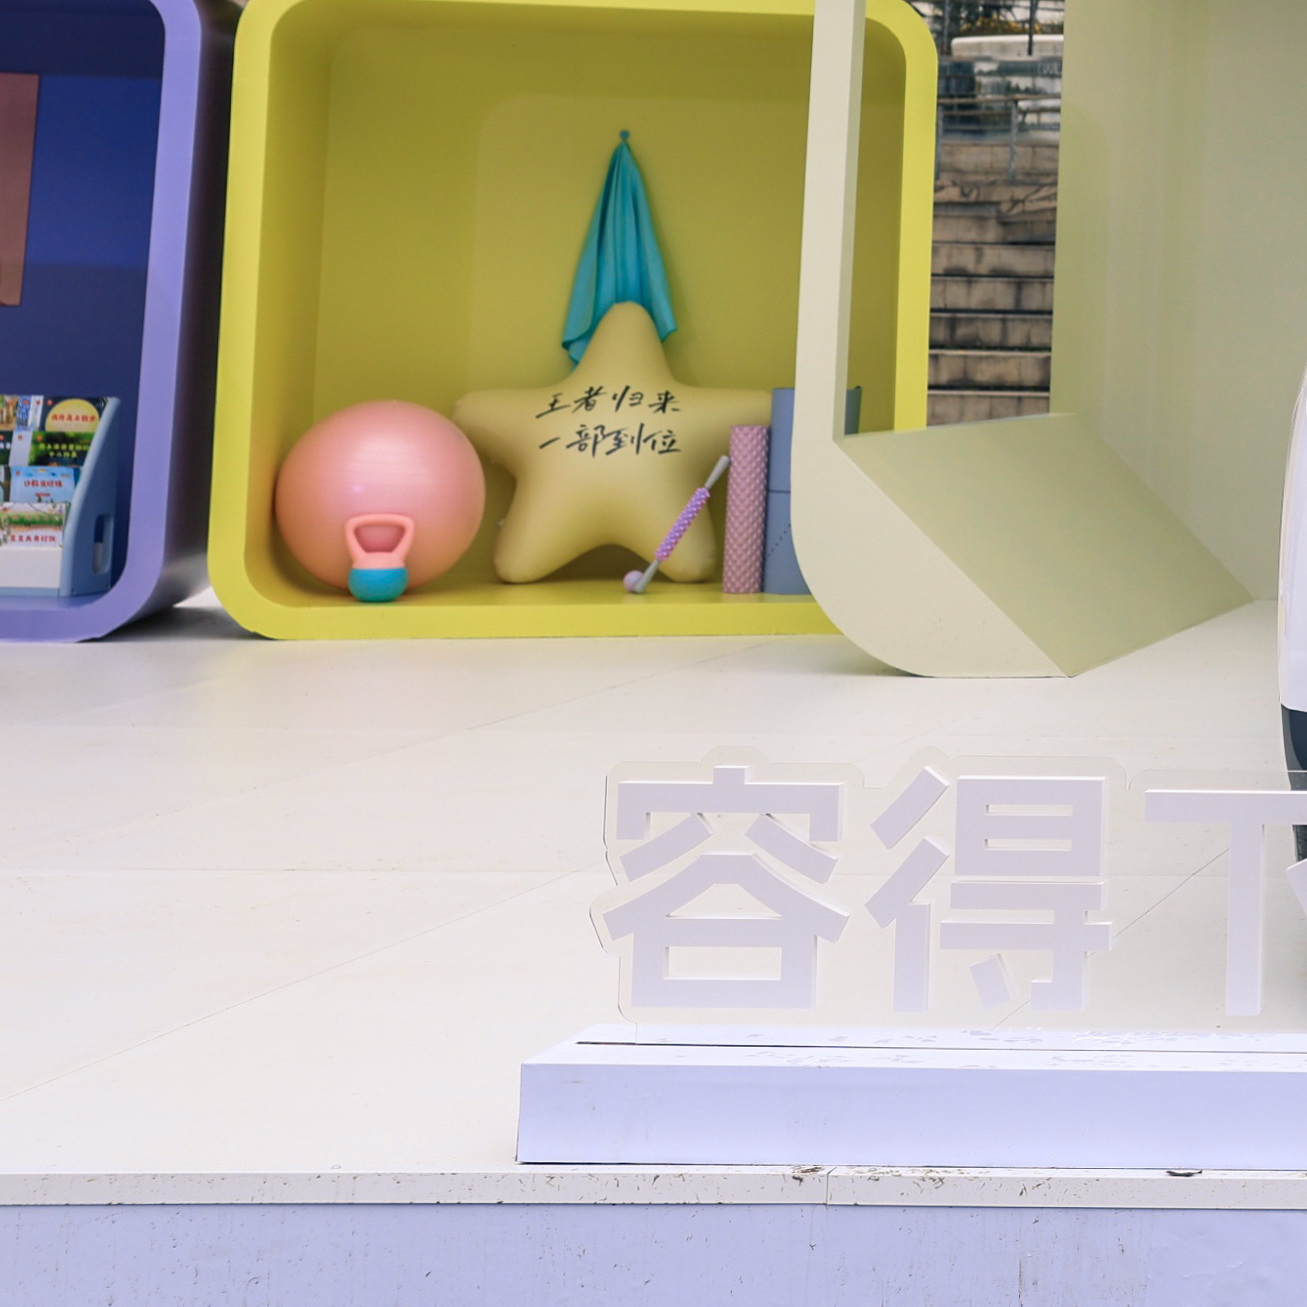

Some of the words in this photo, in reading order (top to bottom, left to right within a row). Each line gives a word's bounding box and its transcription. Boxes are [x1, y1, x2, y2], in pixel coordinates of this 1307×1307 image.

[535, 385, 681, 419] 王者归来
[539, 422, 681, 458] 一部到位
